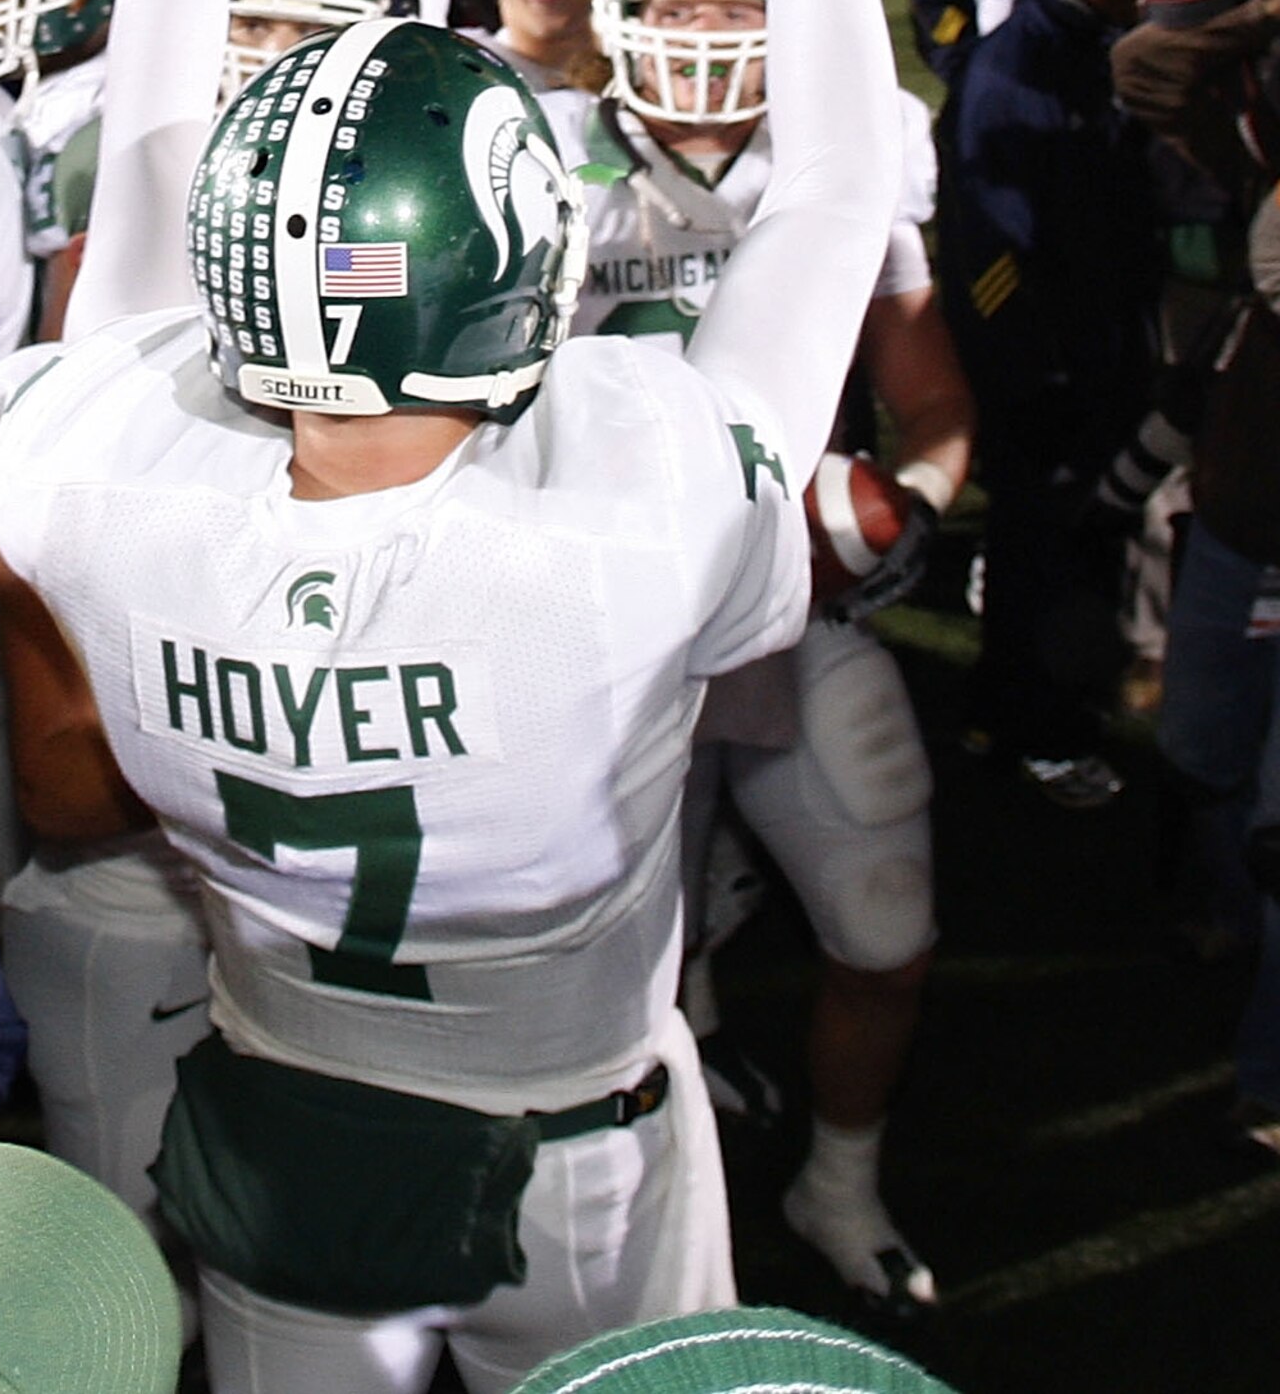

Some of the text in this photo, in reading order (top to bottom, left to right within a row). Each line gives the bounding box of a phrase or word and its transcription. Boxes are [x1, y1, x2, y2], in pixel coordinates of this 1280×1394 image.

[588, 249, 732, 296] MICHIGA
[325, 305, 363, 365] 7
[261, 379, 344, 402] schutt
[161, 640, 468, 768] HOYER
[214, 769, 435, 1003] 7
